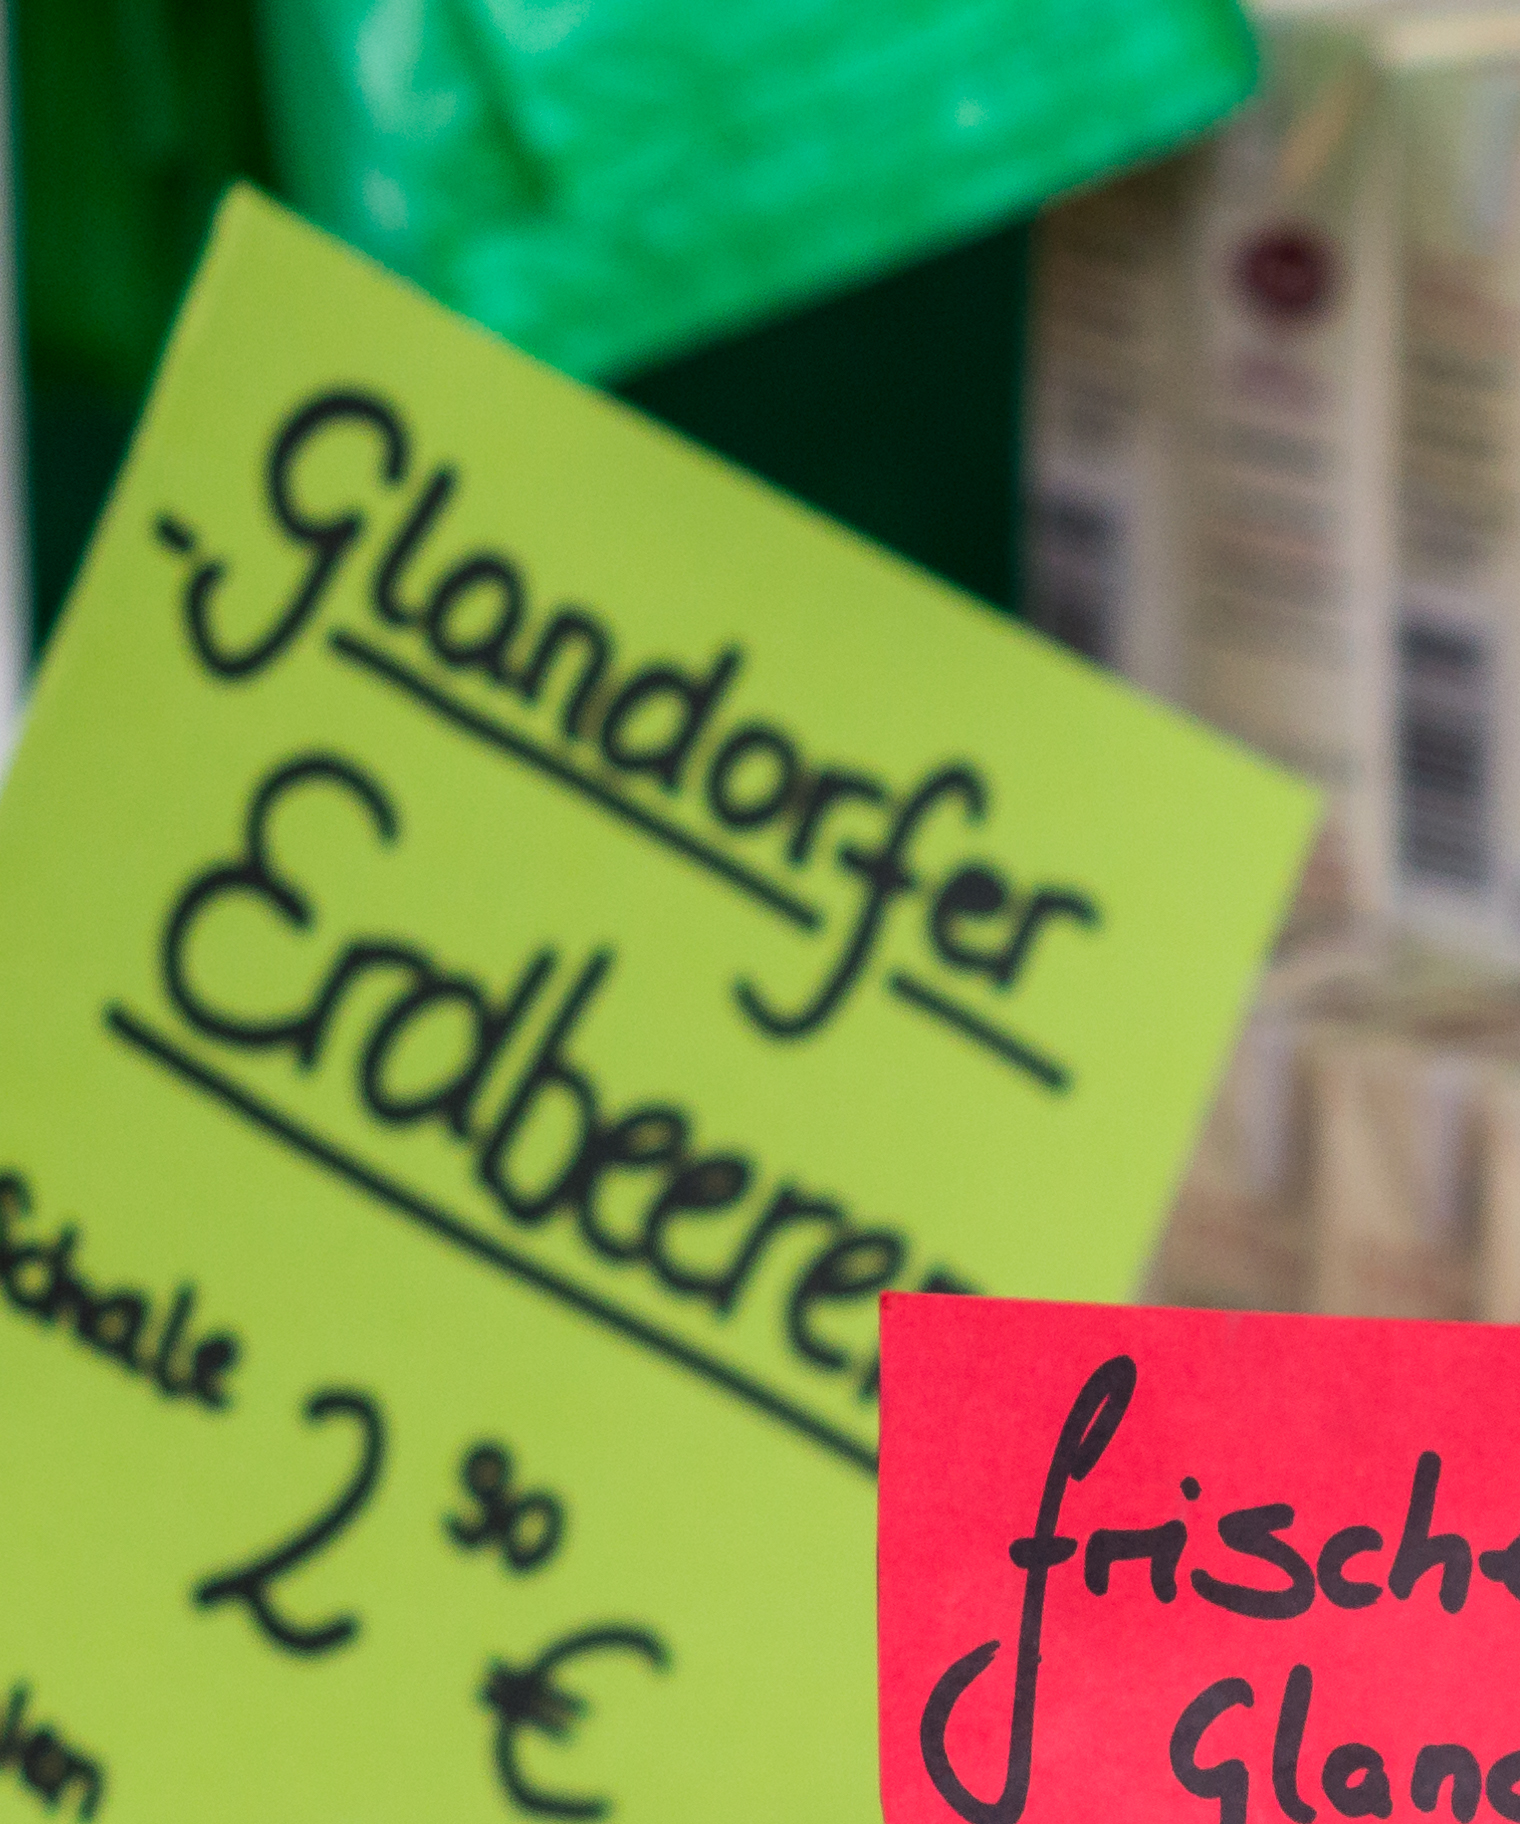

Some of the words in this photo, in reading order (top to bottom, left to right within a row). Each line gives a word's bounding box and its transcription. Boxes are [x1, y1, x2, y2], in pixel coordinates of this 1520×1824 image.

[180, 386, 1098, 1043] Glandorfer
[191, 1385, 388, 1660] 2
[478, 1622, 672, 1824] €
